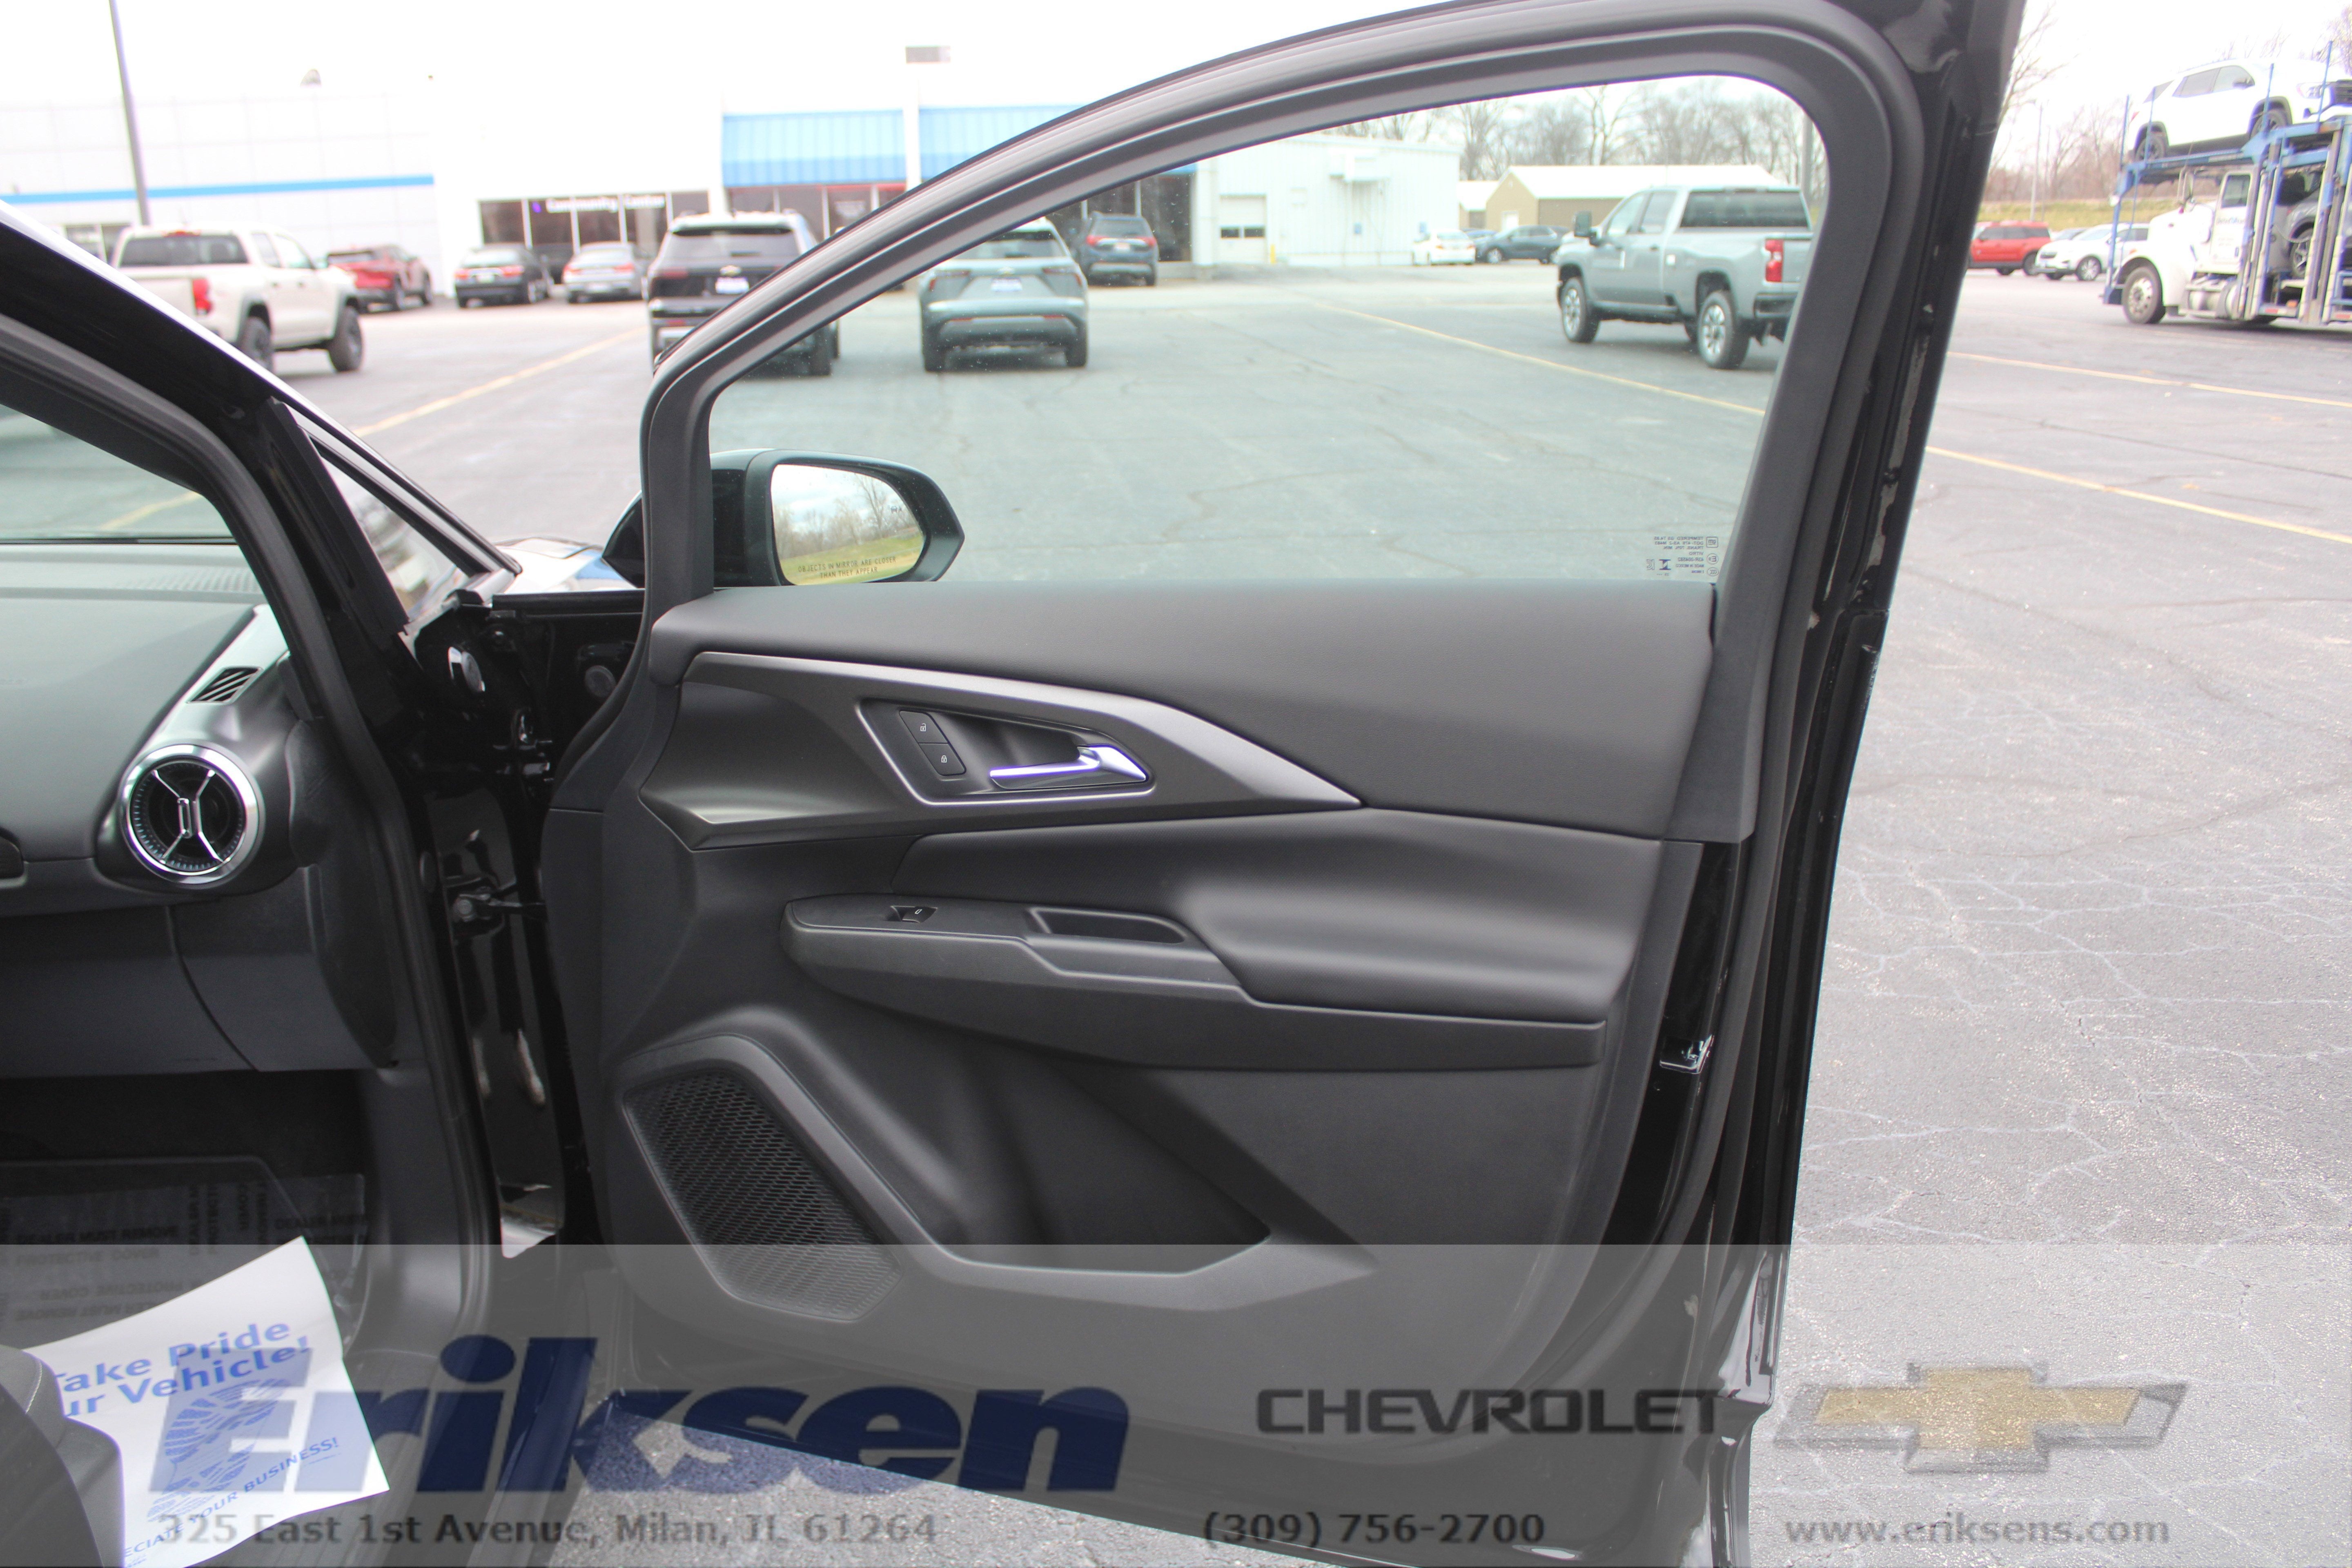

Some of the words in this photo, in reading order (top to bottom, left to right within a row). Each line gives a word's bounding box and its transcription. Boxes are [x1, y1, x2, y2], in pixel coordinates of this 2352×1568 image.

[798, 564, 826, 572] OBJECTS
[836, 560, 858, 568] MIRROR
[875, 556, 896, 565] CLOSER
[856, 566, 878, 575] APPEAR
[16, 1232, 76, 1245] DEALER
[80, 1229, 117, 1243] MUST
[121, 1225, 179, 1240] REMOVE
[16, 1250, 103, 1265] PROTECTIVE
[111, 1247, 160, 1261] COVER
[40, 1286, 89, 1300] COVER
[96, 1281, 183, 1296] PROTECTIVE
[55, 1359, 151, 1392] ake
[168, 1322, 291, 1366] Pride
[117, 1336, 311, 1403] Vehicle!
[189, 1491, 240, 1524] YOUR
[244, 1437, 339, 1492] BUSINESS!
